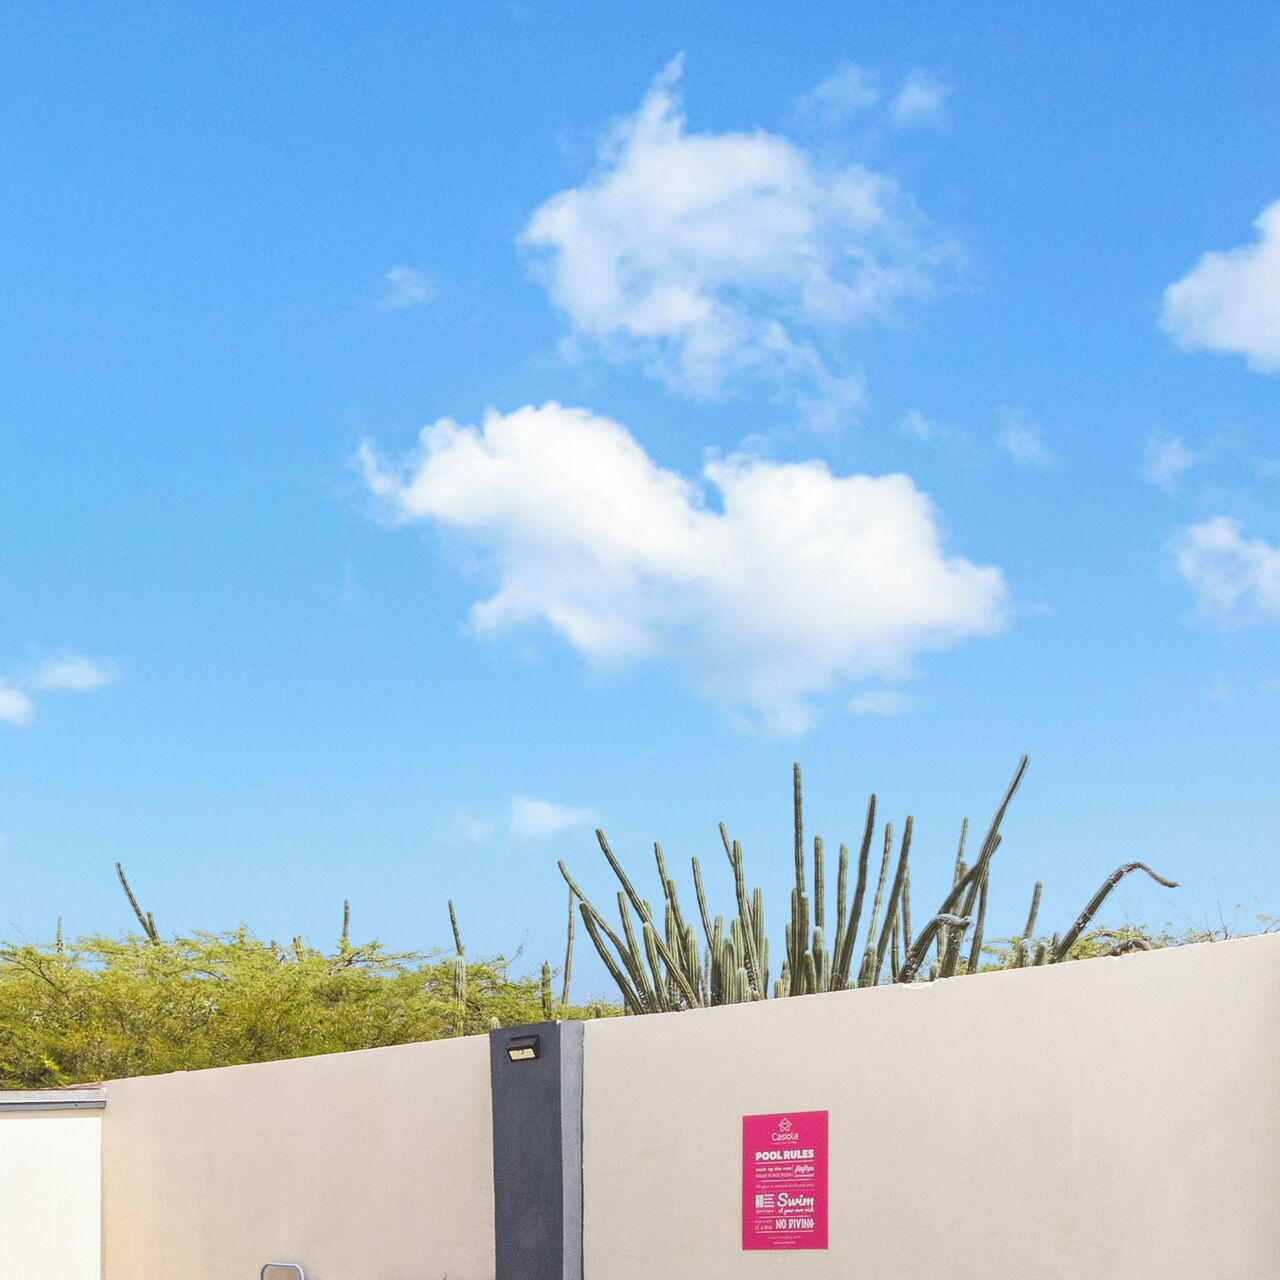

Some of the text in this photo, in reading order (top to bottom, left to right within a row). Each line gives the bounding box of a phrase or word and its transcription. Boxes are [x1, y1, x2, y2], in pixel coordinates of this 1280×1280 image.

[771, 1132, 799, 1142] Casiola
[755, 1149, 815, 1161] POOL RULES
[776, 1192, 815, 1207] Swim
[775, 1218, 787, 1229] NO
[788, 1218, 816, 1229] DIVING
